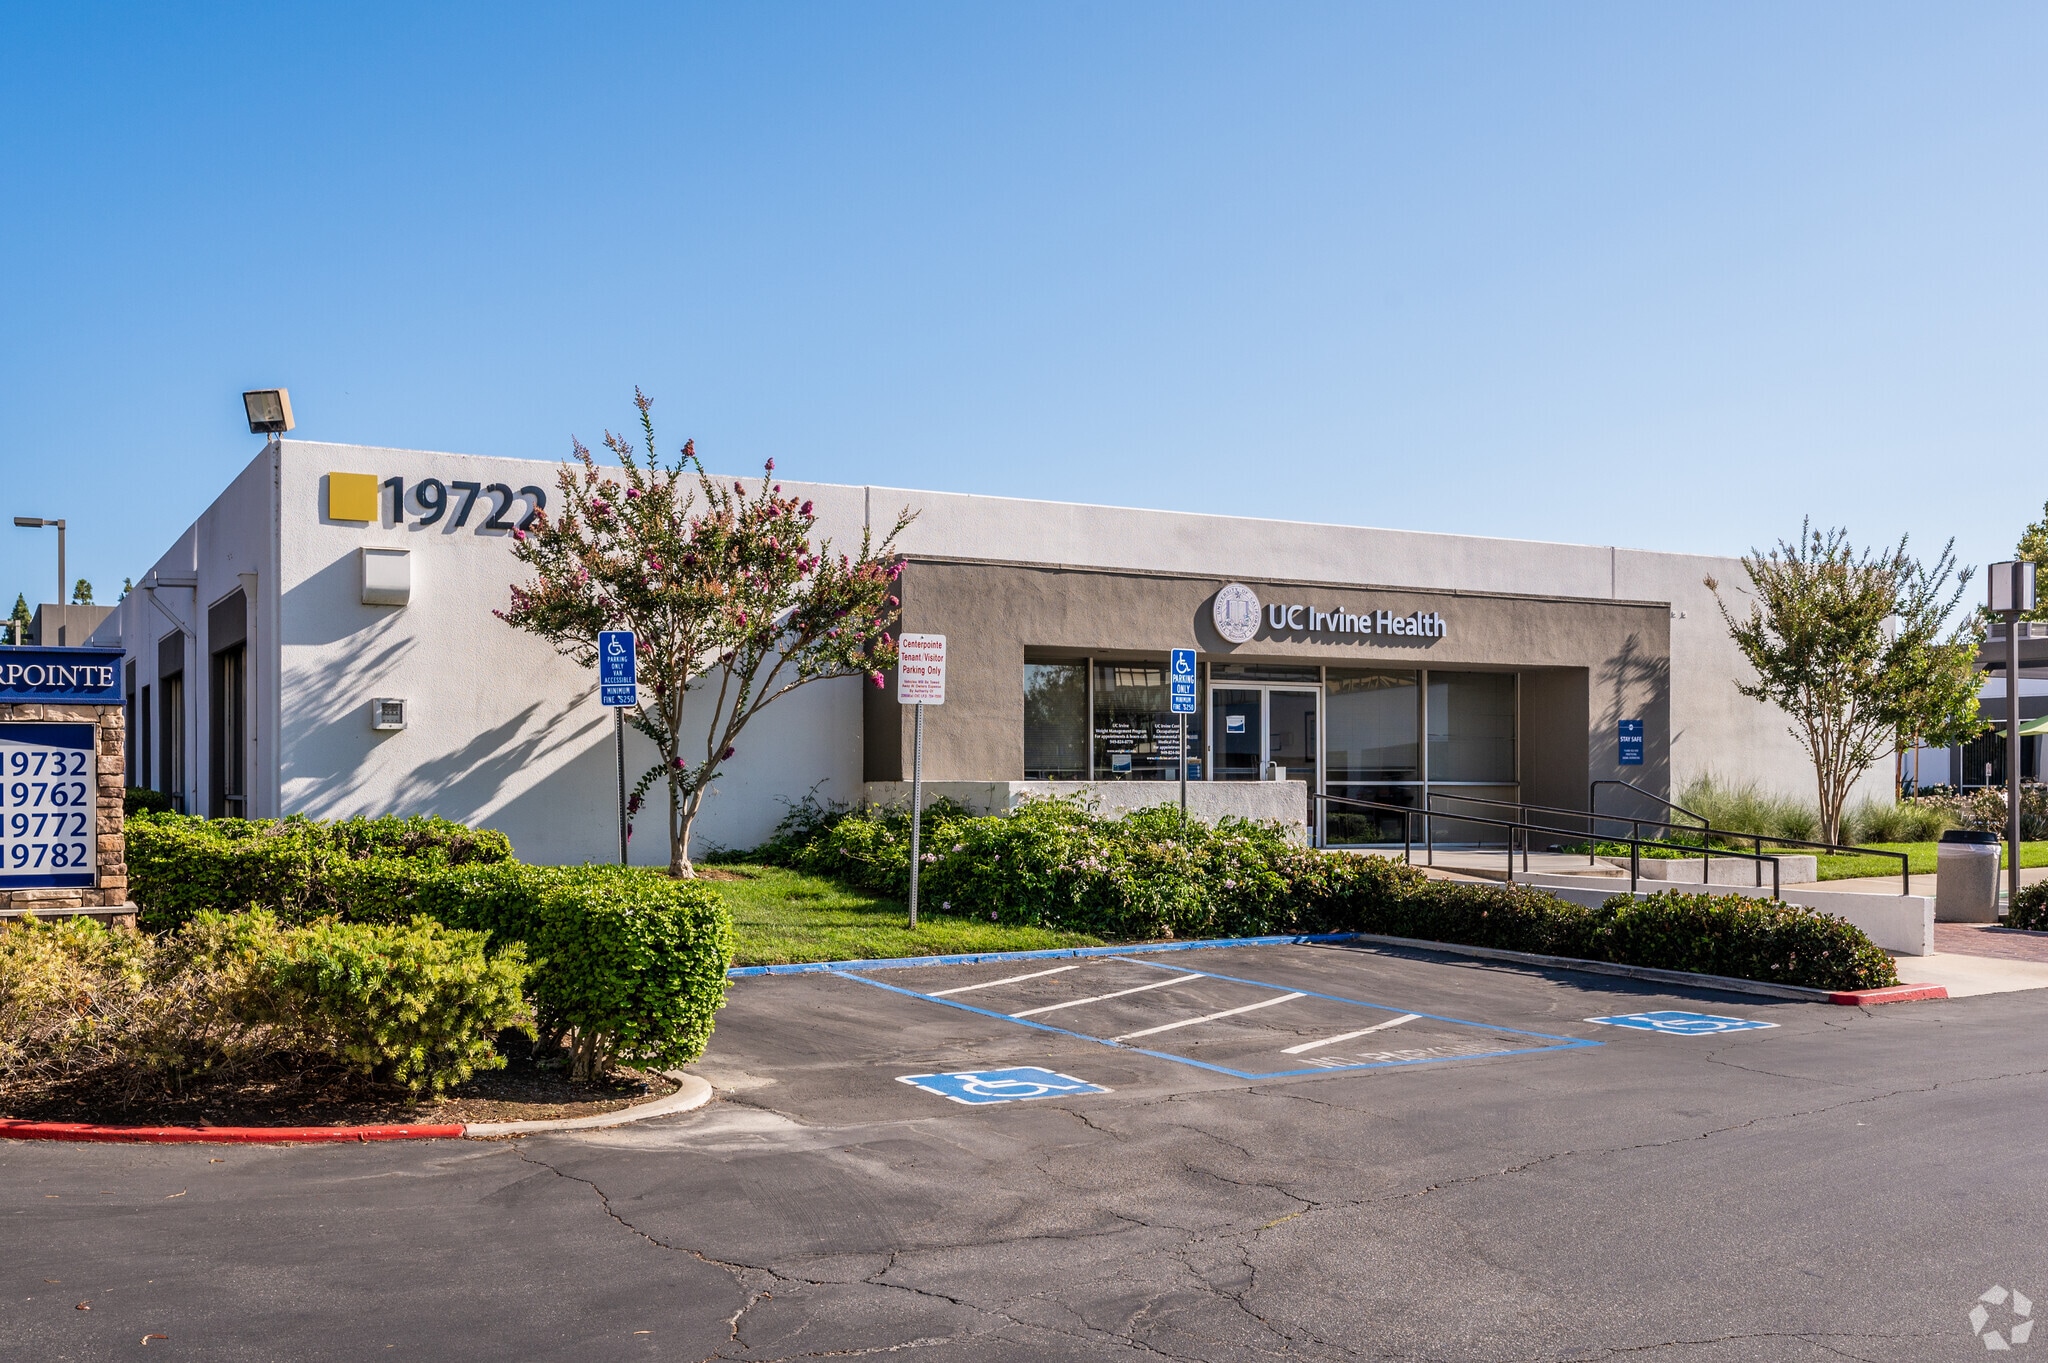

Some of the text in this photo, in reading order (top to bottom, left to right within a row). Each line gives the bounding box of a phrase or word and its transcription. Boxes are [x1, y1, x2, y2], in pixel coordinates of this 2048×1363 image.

[384, 476, 547, 531] 19722
[1269, 603, 1447, 637] UC Irvine Health
[903, 638, 943, 650] Centerpointe
[902, 664, 941, 676] Parking Only
[1172, 674, 1195, 684] PARKING
[606, 687, 631, 695] MINIMUM
[1176, 684, 1191, 694] ONLY
[603, 696, 615, 704] FINE
[1172, 703, 1181, 711] FINE
[0, 751, 87, 777] 19732
[0, 782, 87, 807] 19762
[0, 812, 87, 838] 19772
[0, 843, 87, 869] 19782
[1296, 1056, 1367, 1069] NO
